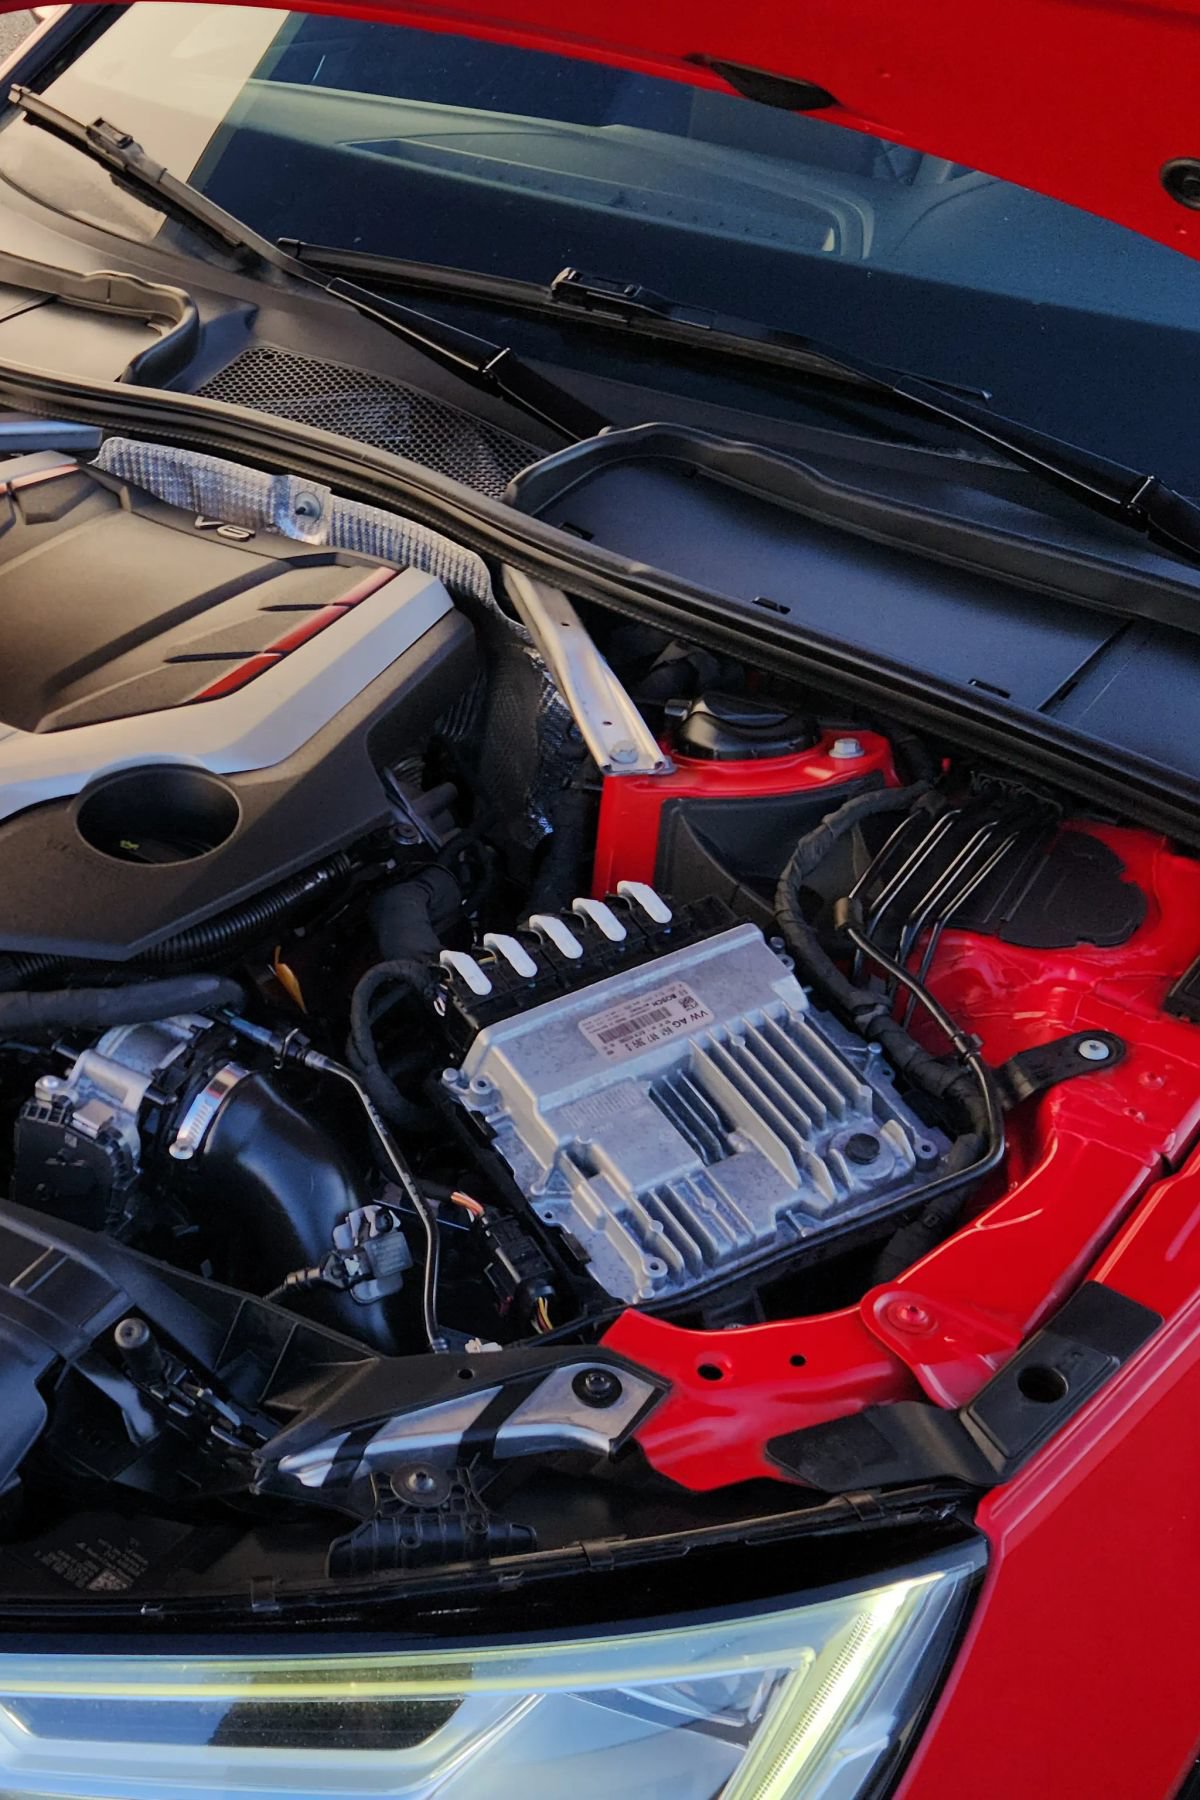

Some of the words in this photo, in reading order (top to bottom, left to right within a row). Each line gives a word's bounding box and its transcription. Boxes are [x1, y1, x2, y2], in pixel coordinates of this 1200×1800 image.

[194, 515, 256, 541] V6
[671, 1017, 688, 1029] AG
[690, 1010, 708, 1023] VW
